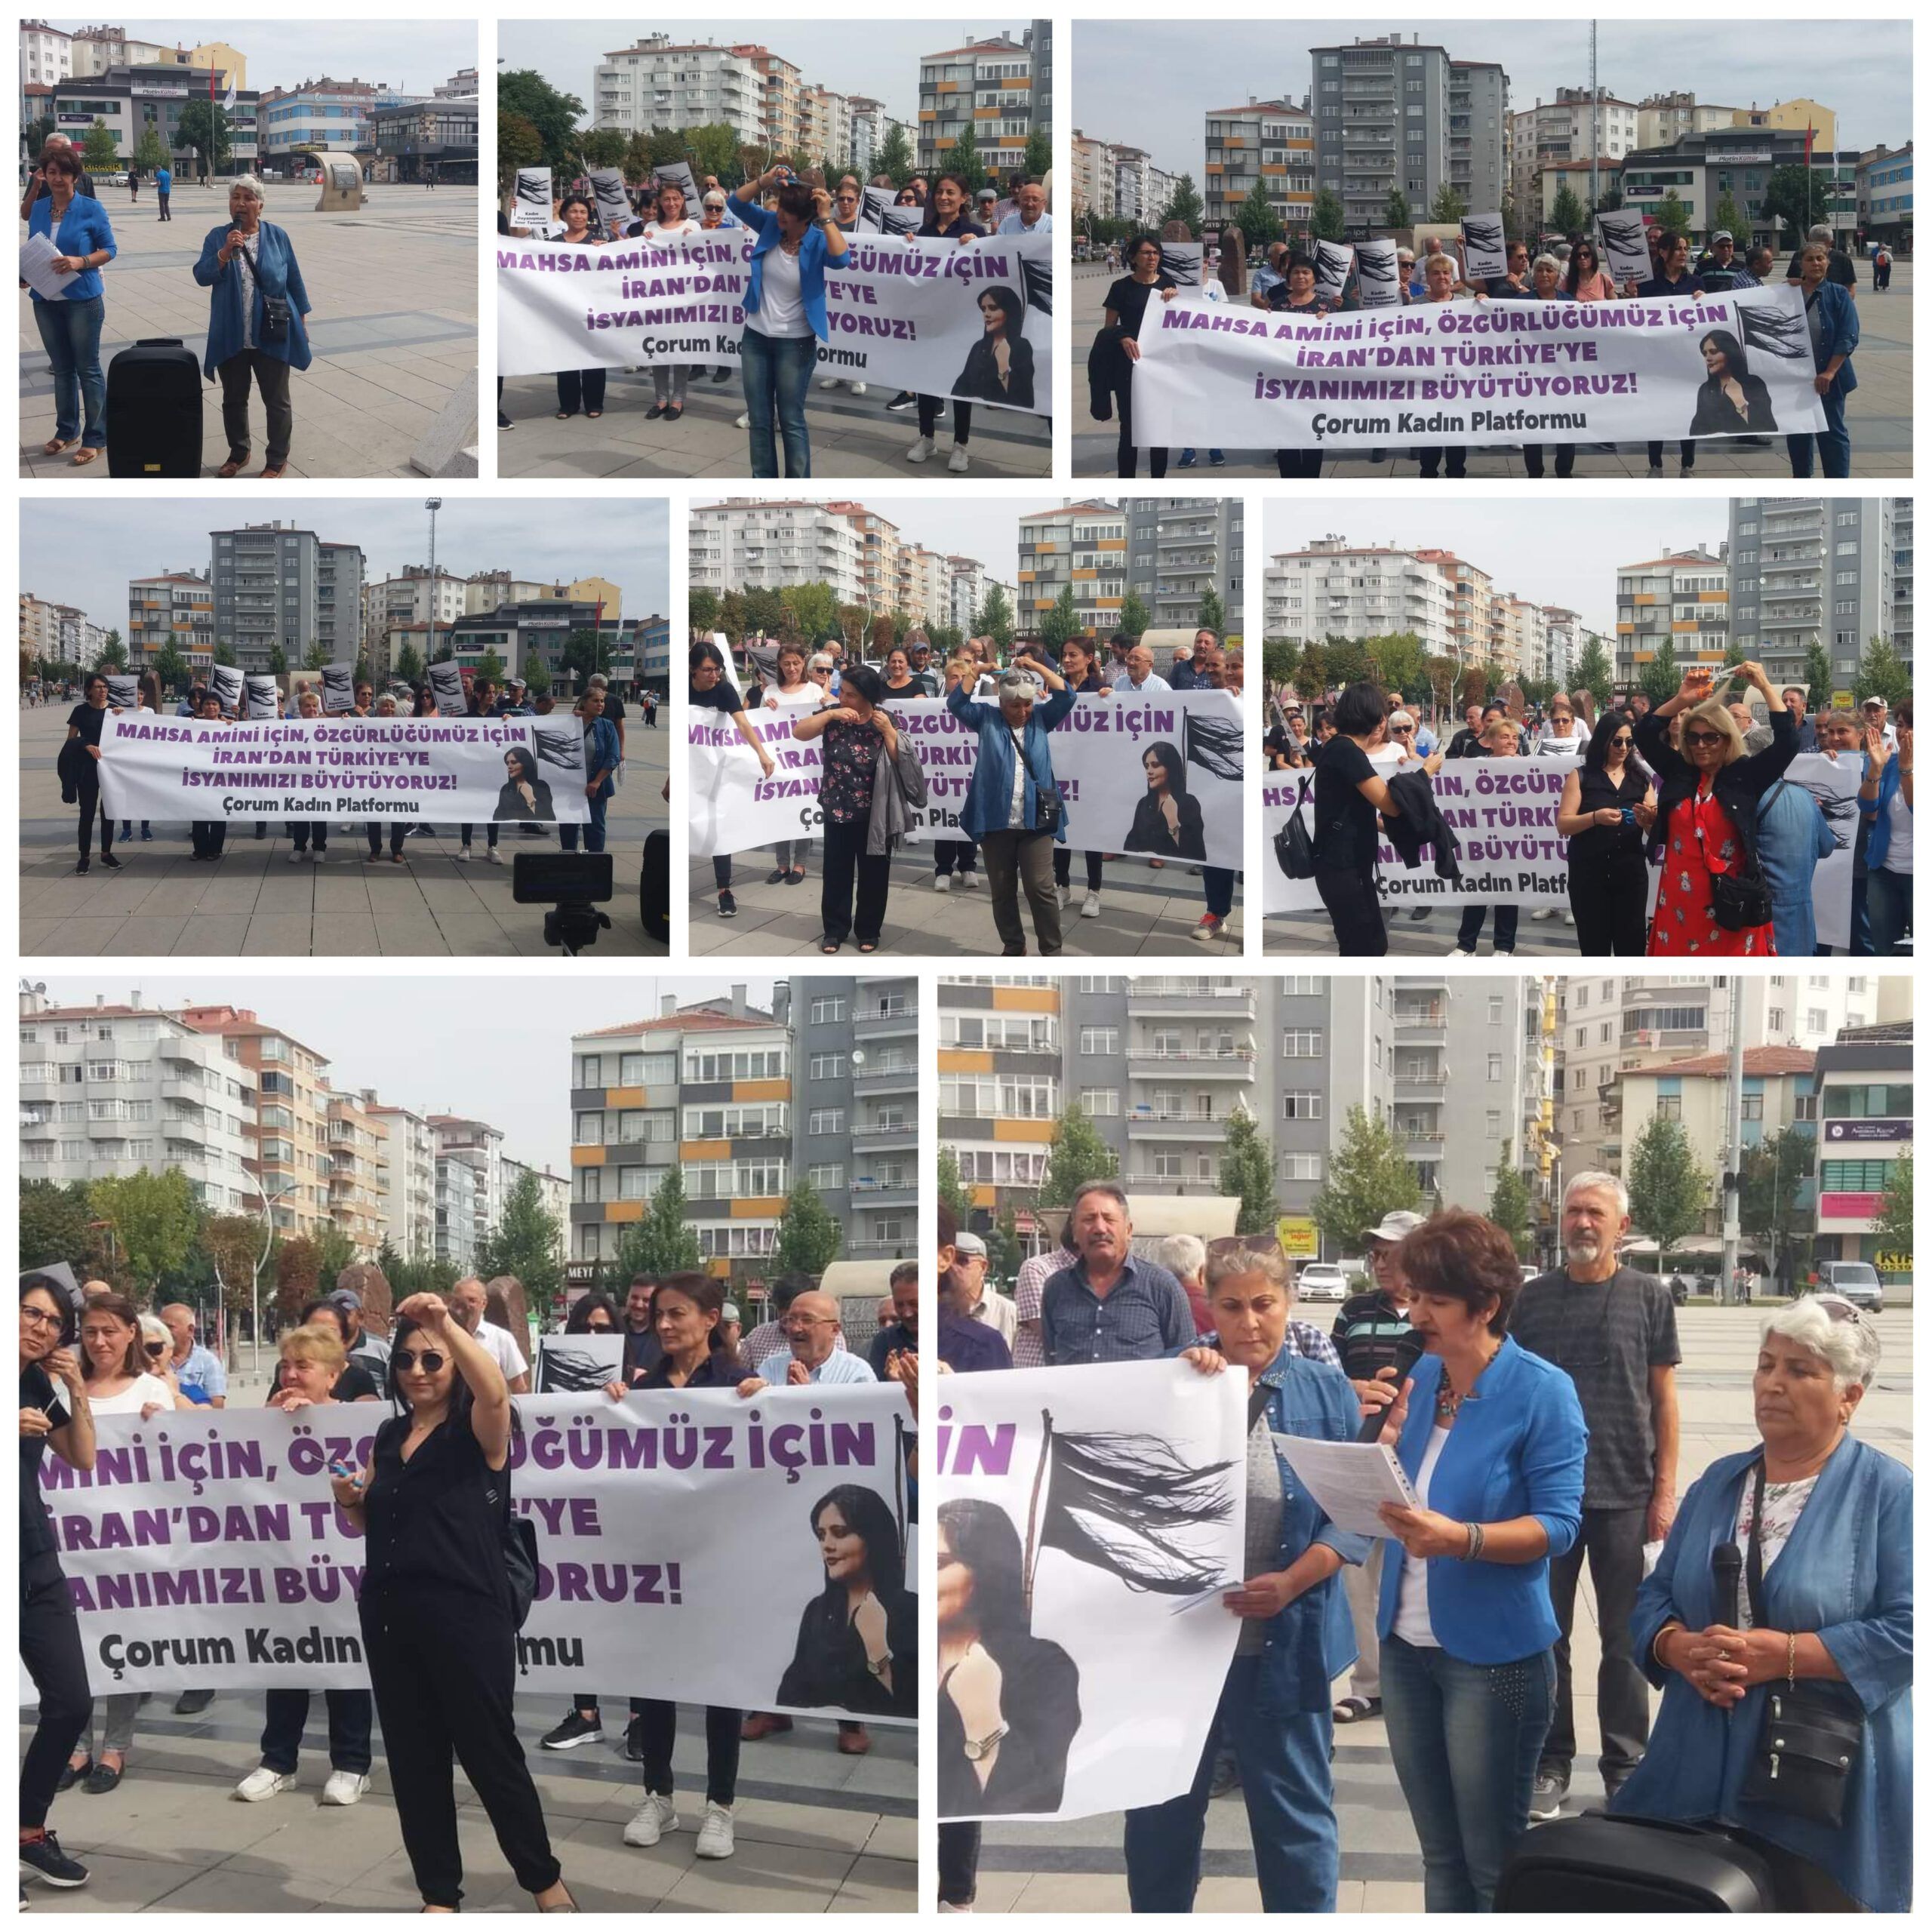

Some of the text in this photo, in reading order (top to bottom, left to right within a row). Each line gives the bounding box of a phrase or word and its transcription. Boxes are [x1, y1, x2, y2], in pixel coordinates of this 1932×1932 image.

[497, 251, 591, 272] MAHSA
[597, 244, 678, 272] AMİNİ
[683, 239, 737, 271] İÇİN,
[944, 248, 1009, 286] İÇİN
[622, 275, 741, 300] İRAN'DAN
[587, 305, 728, 331] İSYANIMIZI
[1161, 303, 1728, 343] MAHSA AMİNİ İÇİN, ÖZGÜRLÜĞÜMÜZ İÇİN
[641, 336, 711, 358] Çorum
[1296, 337, 1598, 368] İRAN'DAN TÜRKİYE'YE
[1254, 371, 1638, 401] İSYANIMIZI BÜYÜTÜYORUZ!
[1312, 410, 1587, 440] Çorum Kadın Platformu
[115, 722, 526, 748] MAHSA AMİNİ İÇİN, ÖZGÜRLÜĞÜMÜZ İÇİN
[1115, 703, 1174, 741] İÇİN
[213, 746, 429, 766] İRAN'DAN TÜRKİYE'YE
[181, 767, 457, 790] İSYANIMIZI BÜYÜTÜYORUZ!
[223, 795, 420, 814] Çorum Kadın Platformu
[1375, 872, 1567, 900] Çorum Kadın Platf
[160, 1429, 278, 1495] İÇİN,
[747, 1407, 875, 1484] İÇİN
[66, 1567, 265, 1612] ANIMIZI
[99, 1626, 362, 1681] Çorum Kadın
